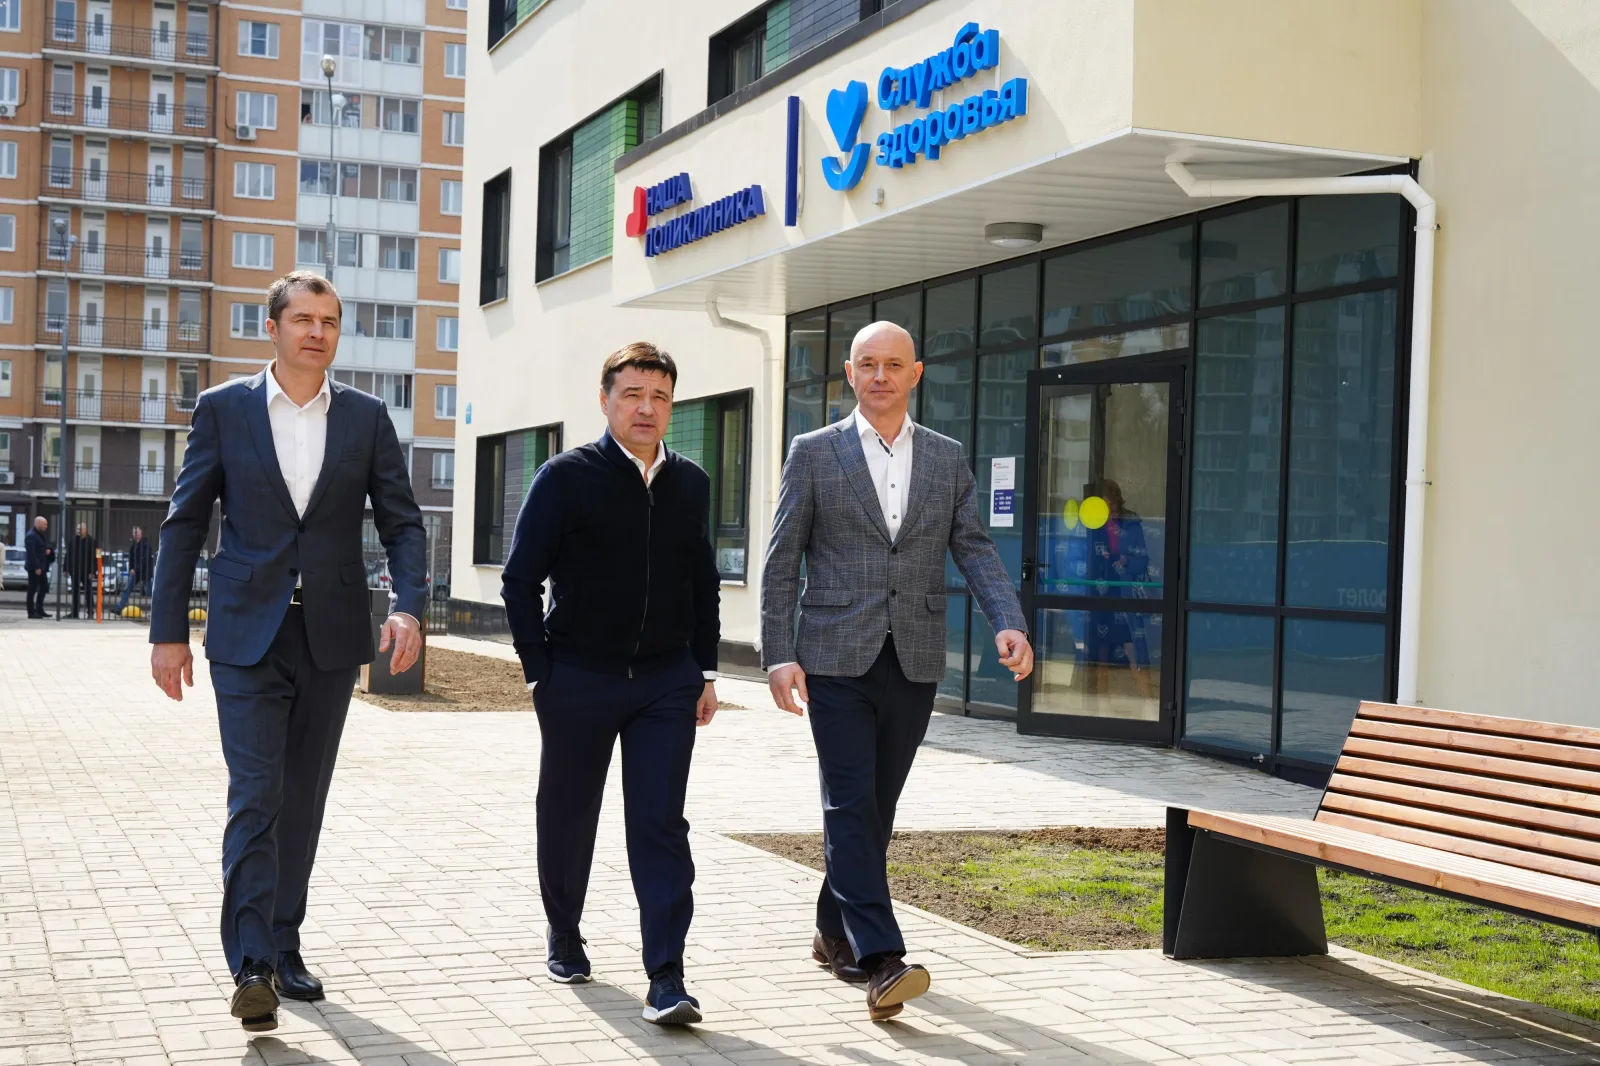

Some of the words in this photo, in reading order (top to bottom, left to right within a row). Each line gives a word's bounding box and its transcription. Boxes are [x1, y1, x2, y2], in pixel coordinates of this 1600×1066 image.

[878, 22, 999, 111] Служба
[876, 78, 1027, 168] здоровья
[645, 172, 693, 216] НАША
[645, 184, 766, 258] ПОЛИКЛИНИКА
